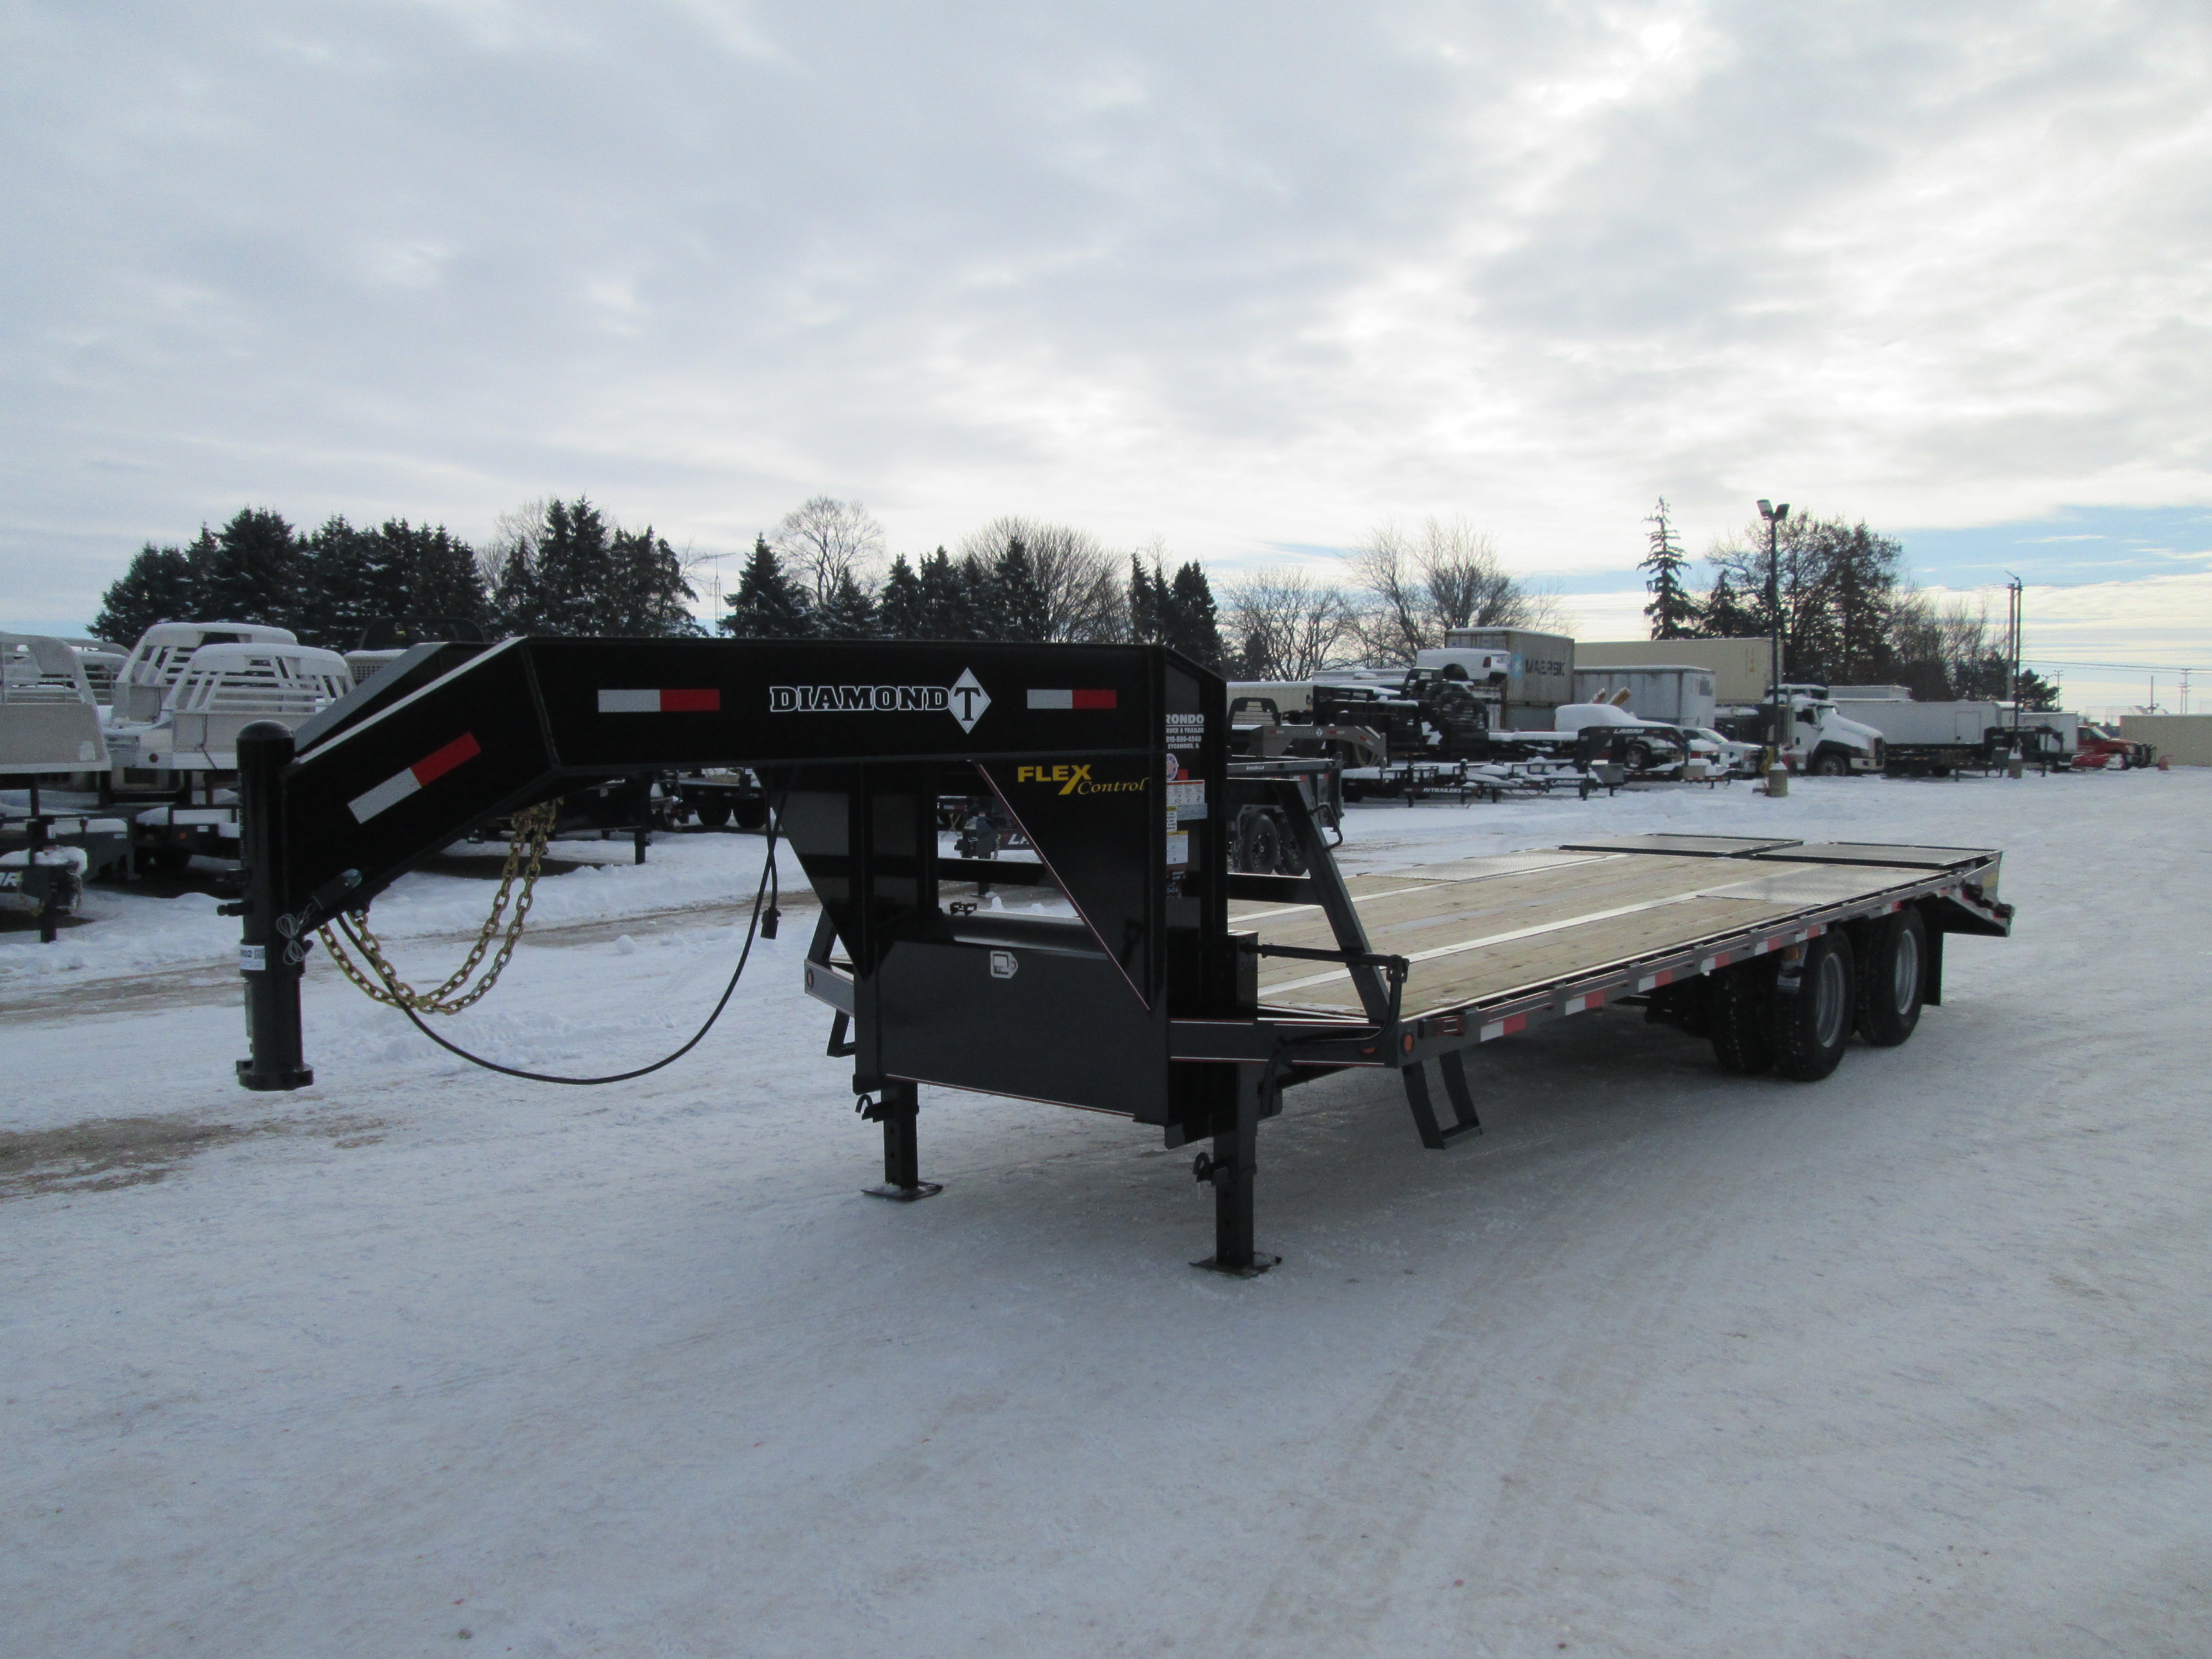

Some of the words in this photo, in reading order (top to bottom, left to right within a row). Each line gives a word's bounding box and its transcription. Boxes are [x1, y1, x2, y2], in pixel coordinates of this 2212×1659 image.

[769, 686, 949, 712] DIAMOND
[1018, 764, 1091, 795] FLEX
[1078, 777, 1149, 795] Control
